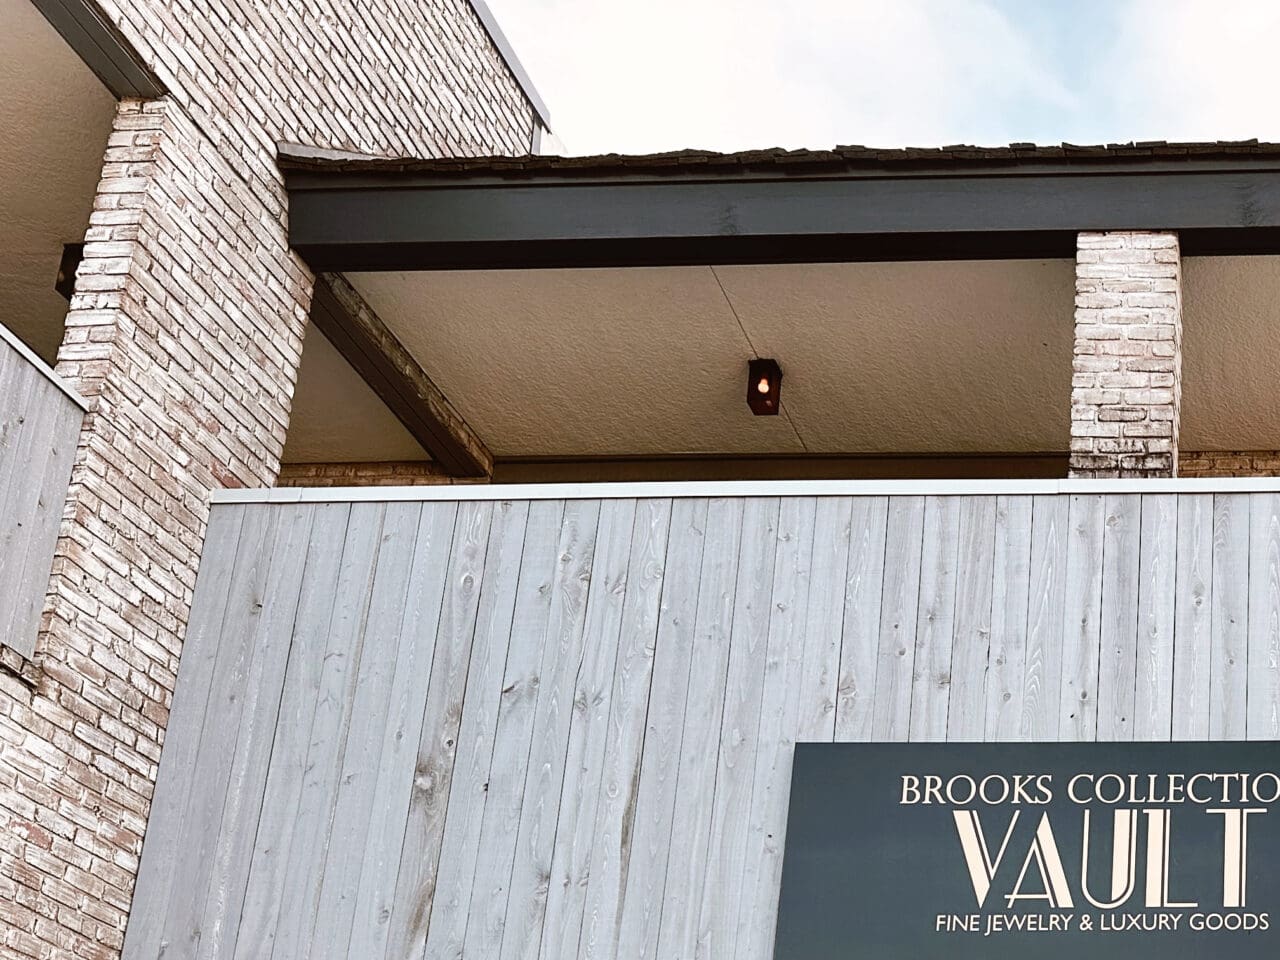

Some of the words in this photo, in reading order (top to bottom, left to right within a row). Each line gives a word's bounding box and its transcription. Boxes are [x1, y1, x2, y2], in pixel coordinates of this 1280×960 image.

[899, 774, 1053, 805] BROOKS
[952, 808, 1268, 909] VAULT
[935, 913, 981, 932] FINE
[983, 913, 1074, 937] JEWELRY
[1079, 913, 1094, 931] &
[1100, 913, 1183, 931] LUXURY
[1189, 912, 1270, 931] GOODS
